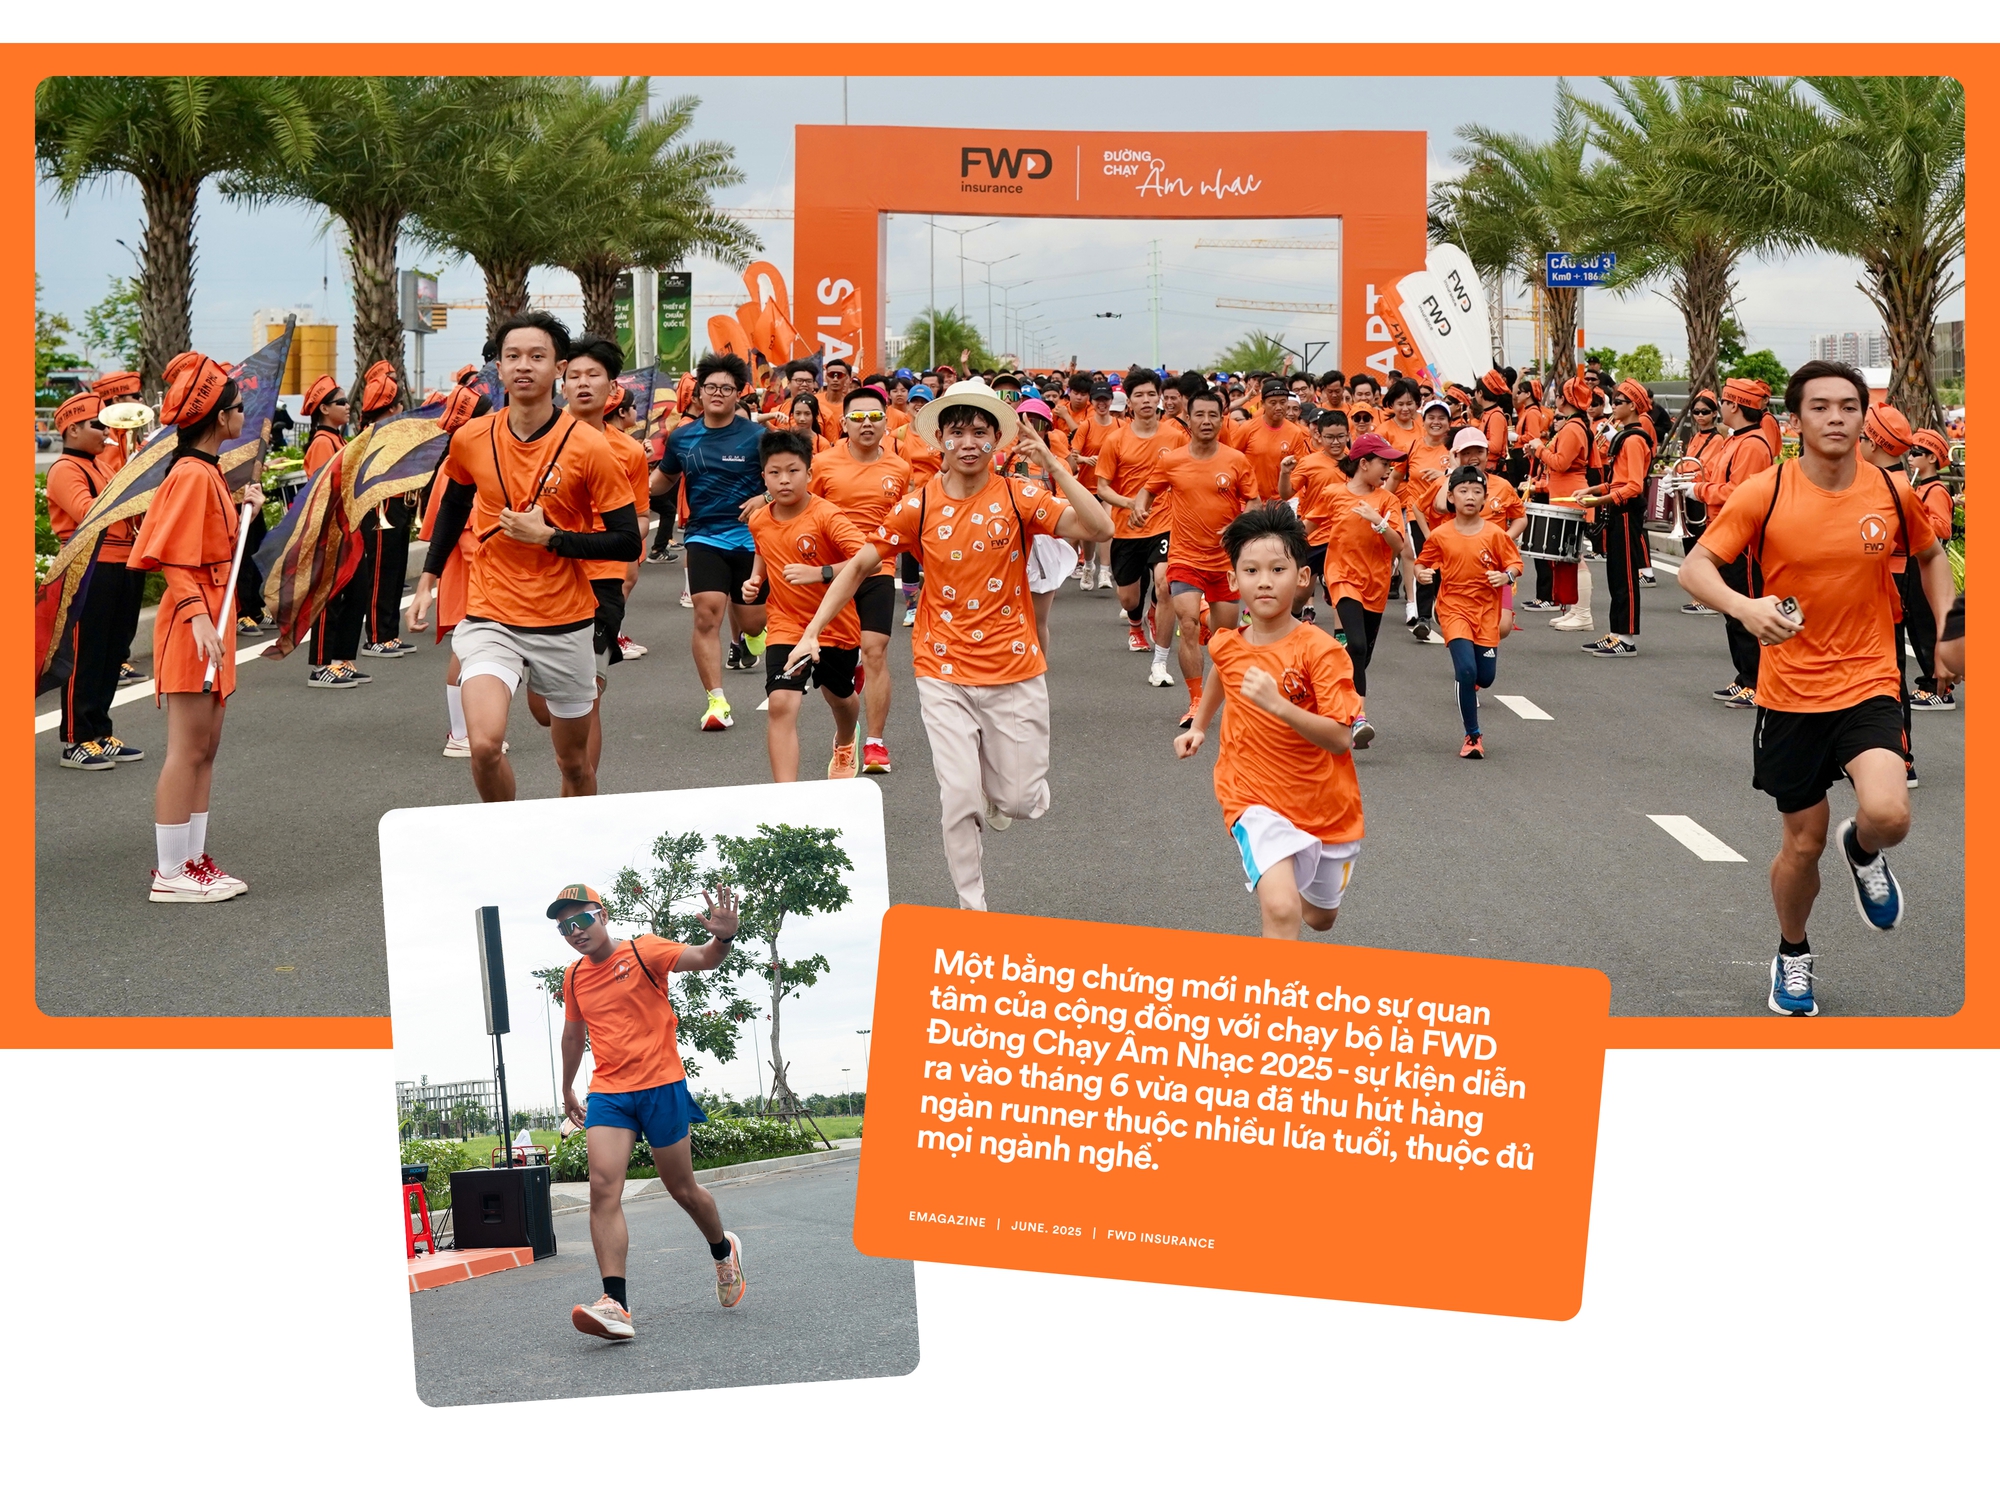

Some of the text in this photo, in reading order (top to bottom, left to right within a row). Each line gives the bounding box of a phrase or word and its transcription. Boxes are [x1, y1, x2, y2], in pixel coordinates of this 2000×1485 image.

[1103, 148, 1152, 163] ĐƯỜNG
[960, 146, 1053, 180] FWD
[1103, 164, 1139, 178] CHẠY
[1135, 158, 1262, 200] Âm nhạc
[960, 181, 1024, 194] insurance
[1602, 257, 1611, 269] 3
[1552, 272, 1572, 281] Km0
[1448, 269, 1472, 313] FWD
[1422, 294, 1452, 337] FWD
[991, 537, 1010, 547] FWD
[1159, 539, 1168, 555] 3
[1864, 542, 1885, 551] FWD
